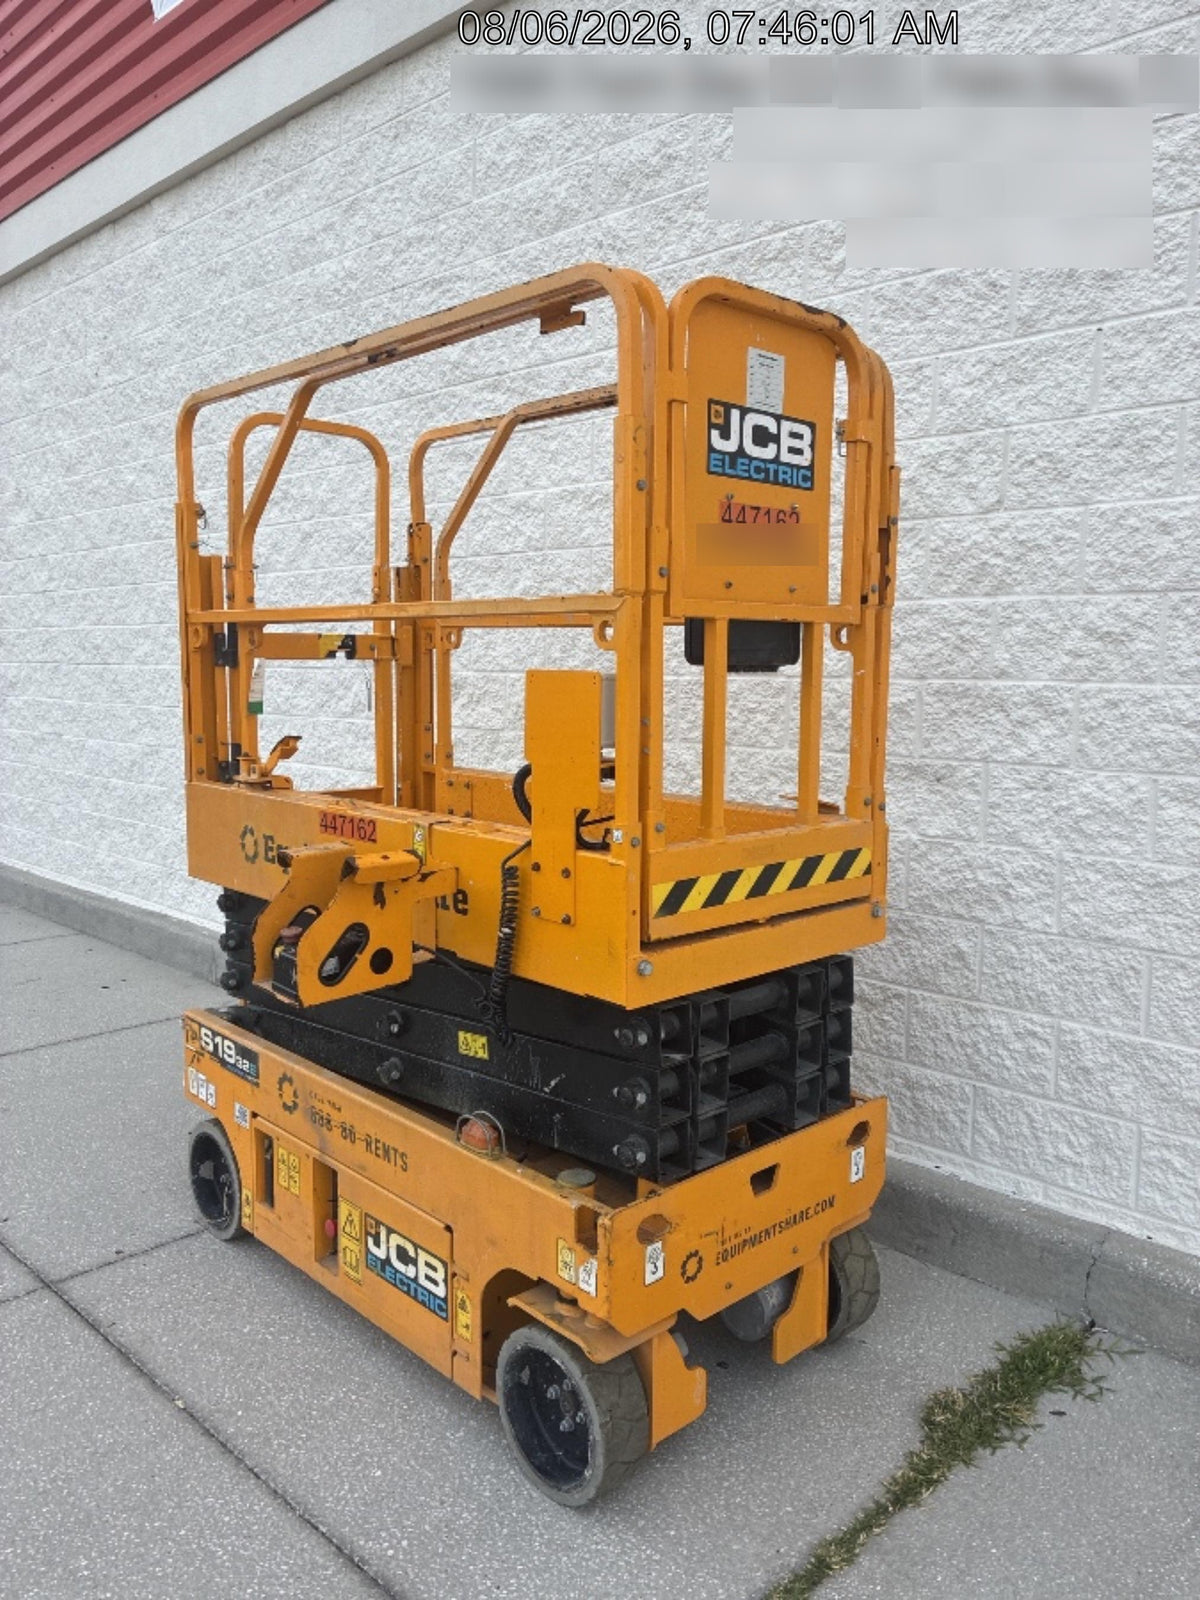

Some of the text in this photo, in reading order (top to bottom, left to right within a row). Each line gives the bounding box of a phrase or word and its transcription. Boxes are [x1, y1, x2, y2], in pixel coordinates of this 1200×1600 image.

[711, 408, 813, 466] JCB
[710, 454, 811, 488] ELECTRIC
[320, 815, 377, 843] 447162
[367, 1223, 446, 1298] JCB
[715, 1195, 836, 1266] EQUIPMENTSHARE.COM
[367, 1252, 447, 1318] ELECTRIC
